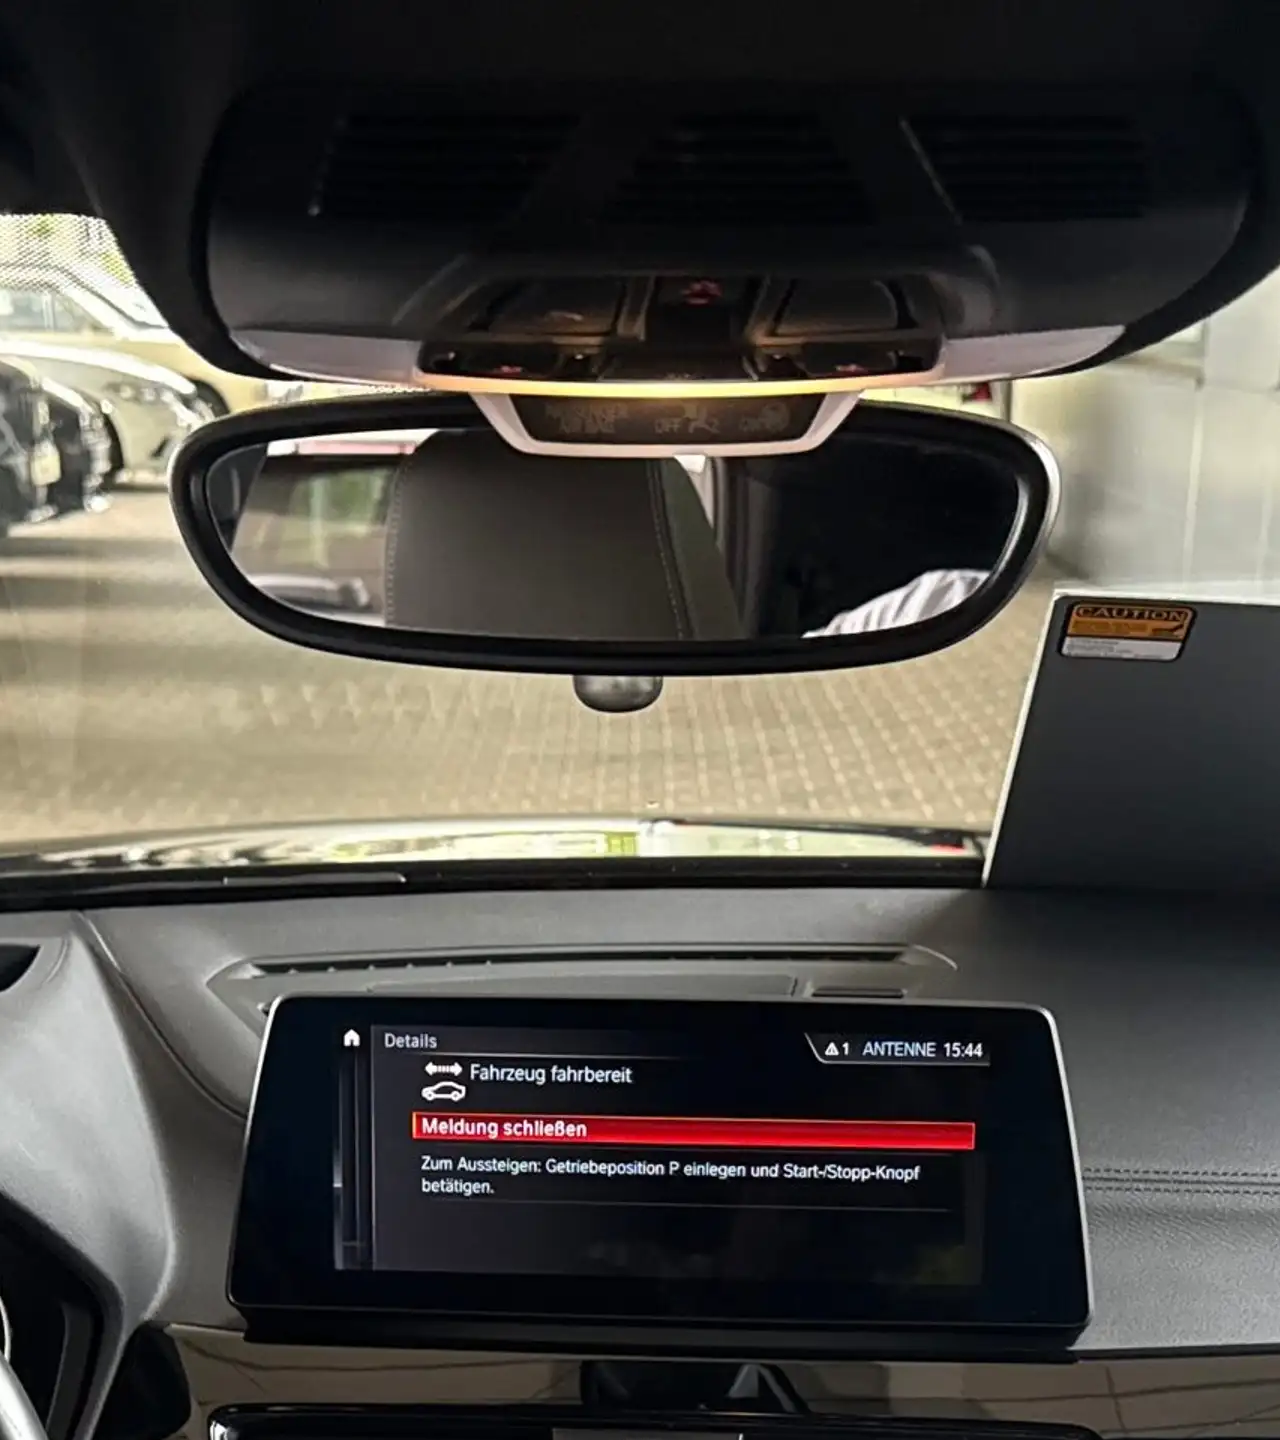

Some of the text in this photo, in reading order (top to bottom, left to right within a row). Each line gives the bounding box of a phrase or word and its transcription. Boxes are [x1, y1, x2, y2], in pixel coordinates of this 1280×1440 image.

[1078, 606, 1185, 622] CAUTION
[384, 1032, 438, 1049] Details
[863, 1042, 937, 1057] ANTENNE
[944, 1042, 983, 1058] 15:44
[470, 1064, 633, 1085] Fahrzeug fahrbereit
[422, 1117, 588, 1139] Meldung schließen
[421, 1155, 921, 1183] Zum Aussteigen: Getriebeposition P einlegen und Start-/Stopp-Knopf
[421, 1177, 495, 1194] betätigen.
